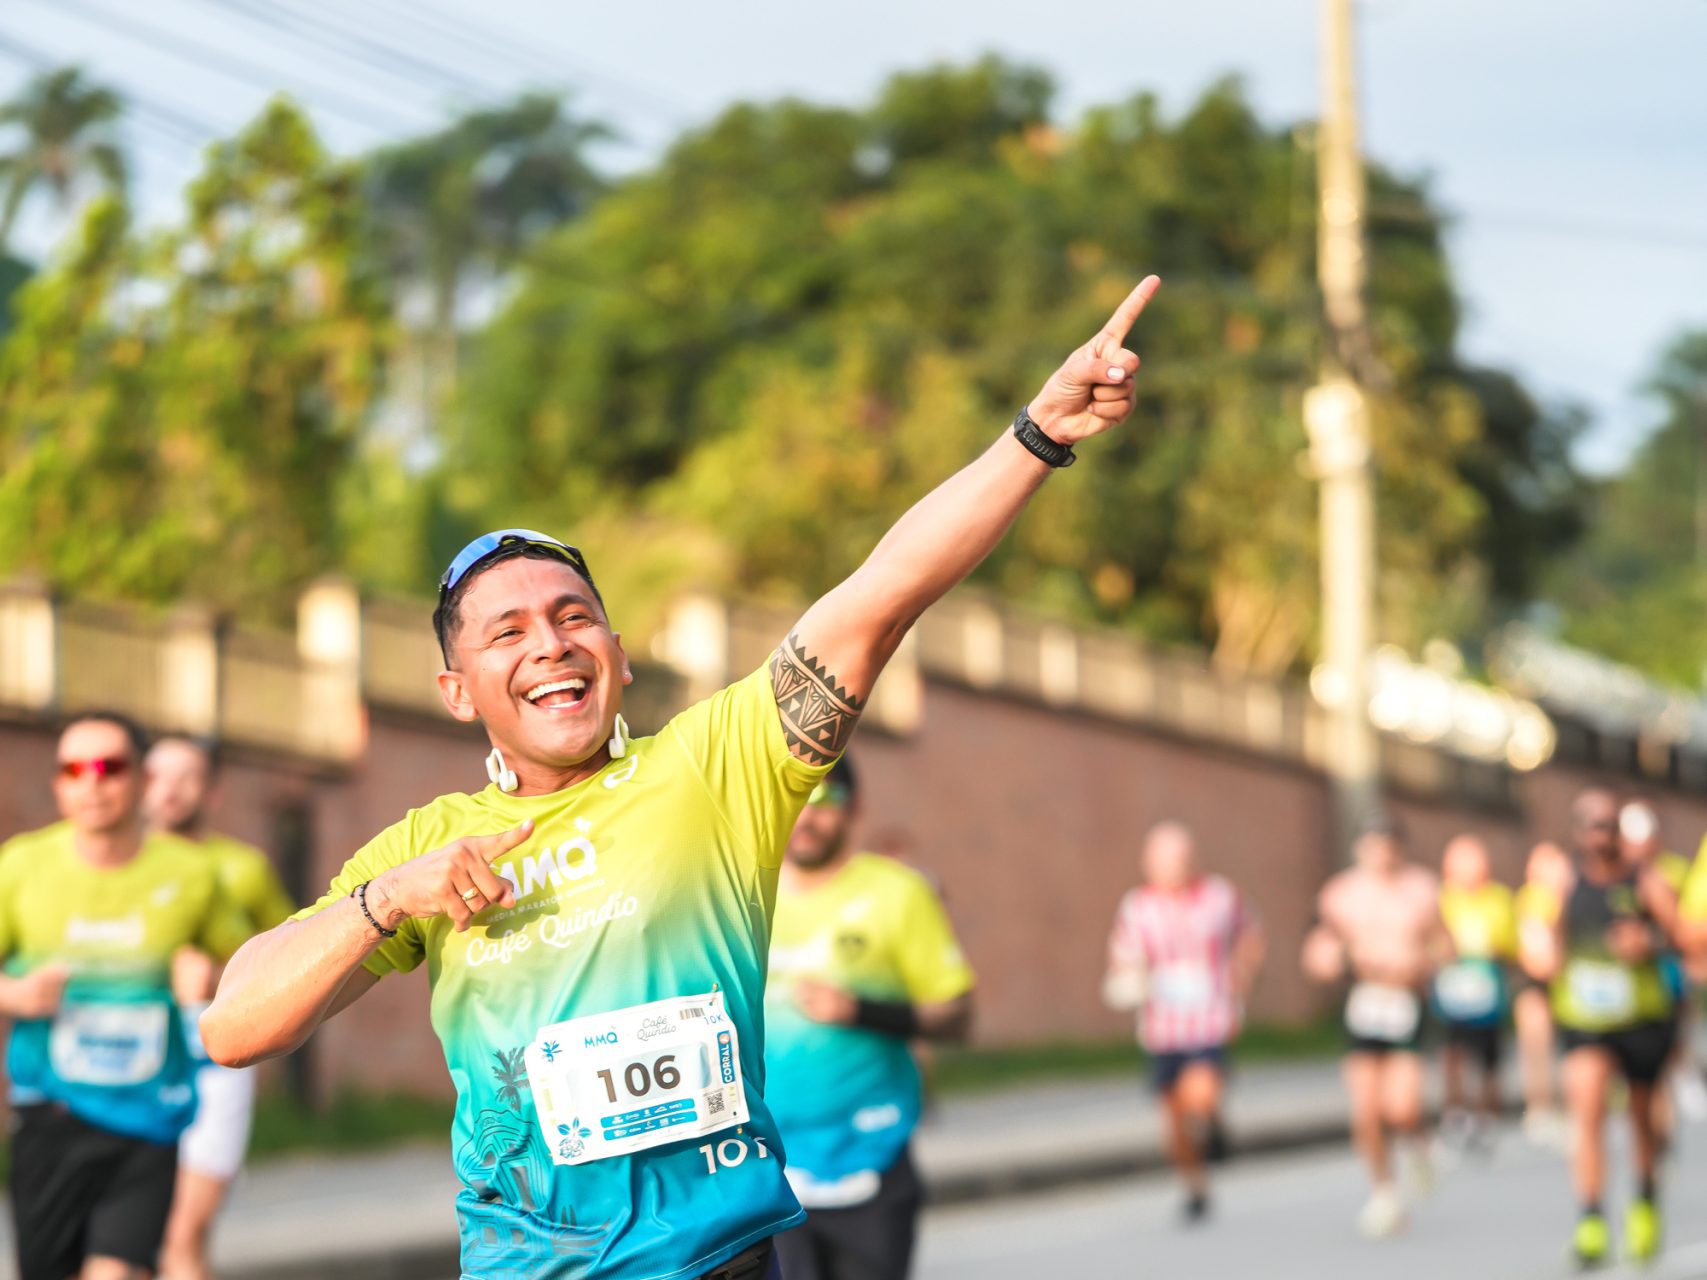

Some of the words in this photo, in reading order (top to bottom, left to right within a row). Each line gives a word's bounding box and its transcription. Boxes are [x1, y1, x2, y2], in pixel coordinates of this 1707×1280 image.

[465, 923, 532, 967] Café
[539, 890, 638, 949] Quindío
[703, 1014, 725, 1025] 10K
[584, 1030, 619, 1049] MMQ
[596, 1054, 681, 1104] 106
[720, 1044, 733, 1083] CORRAL
